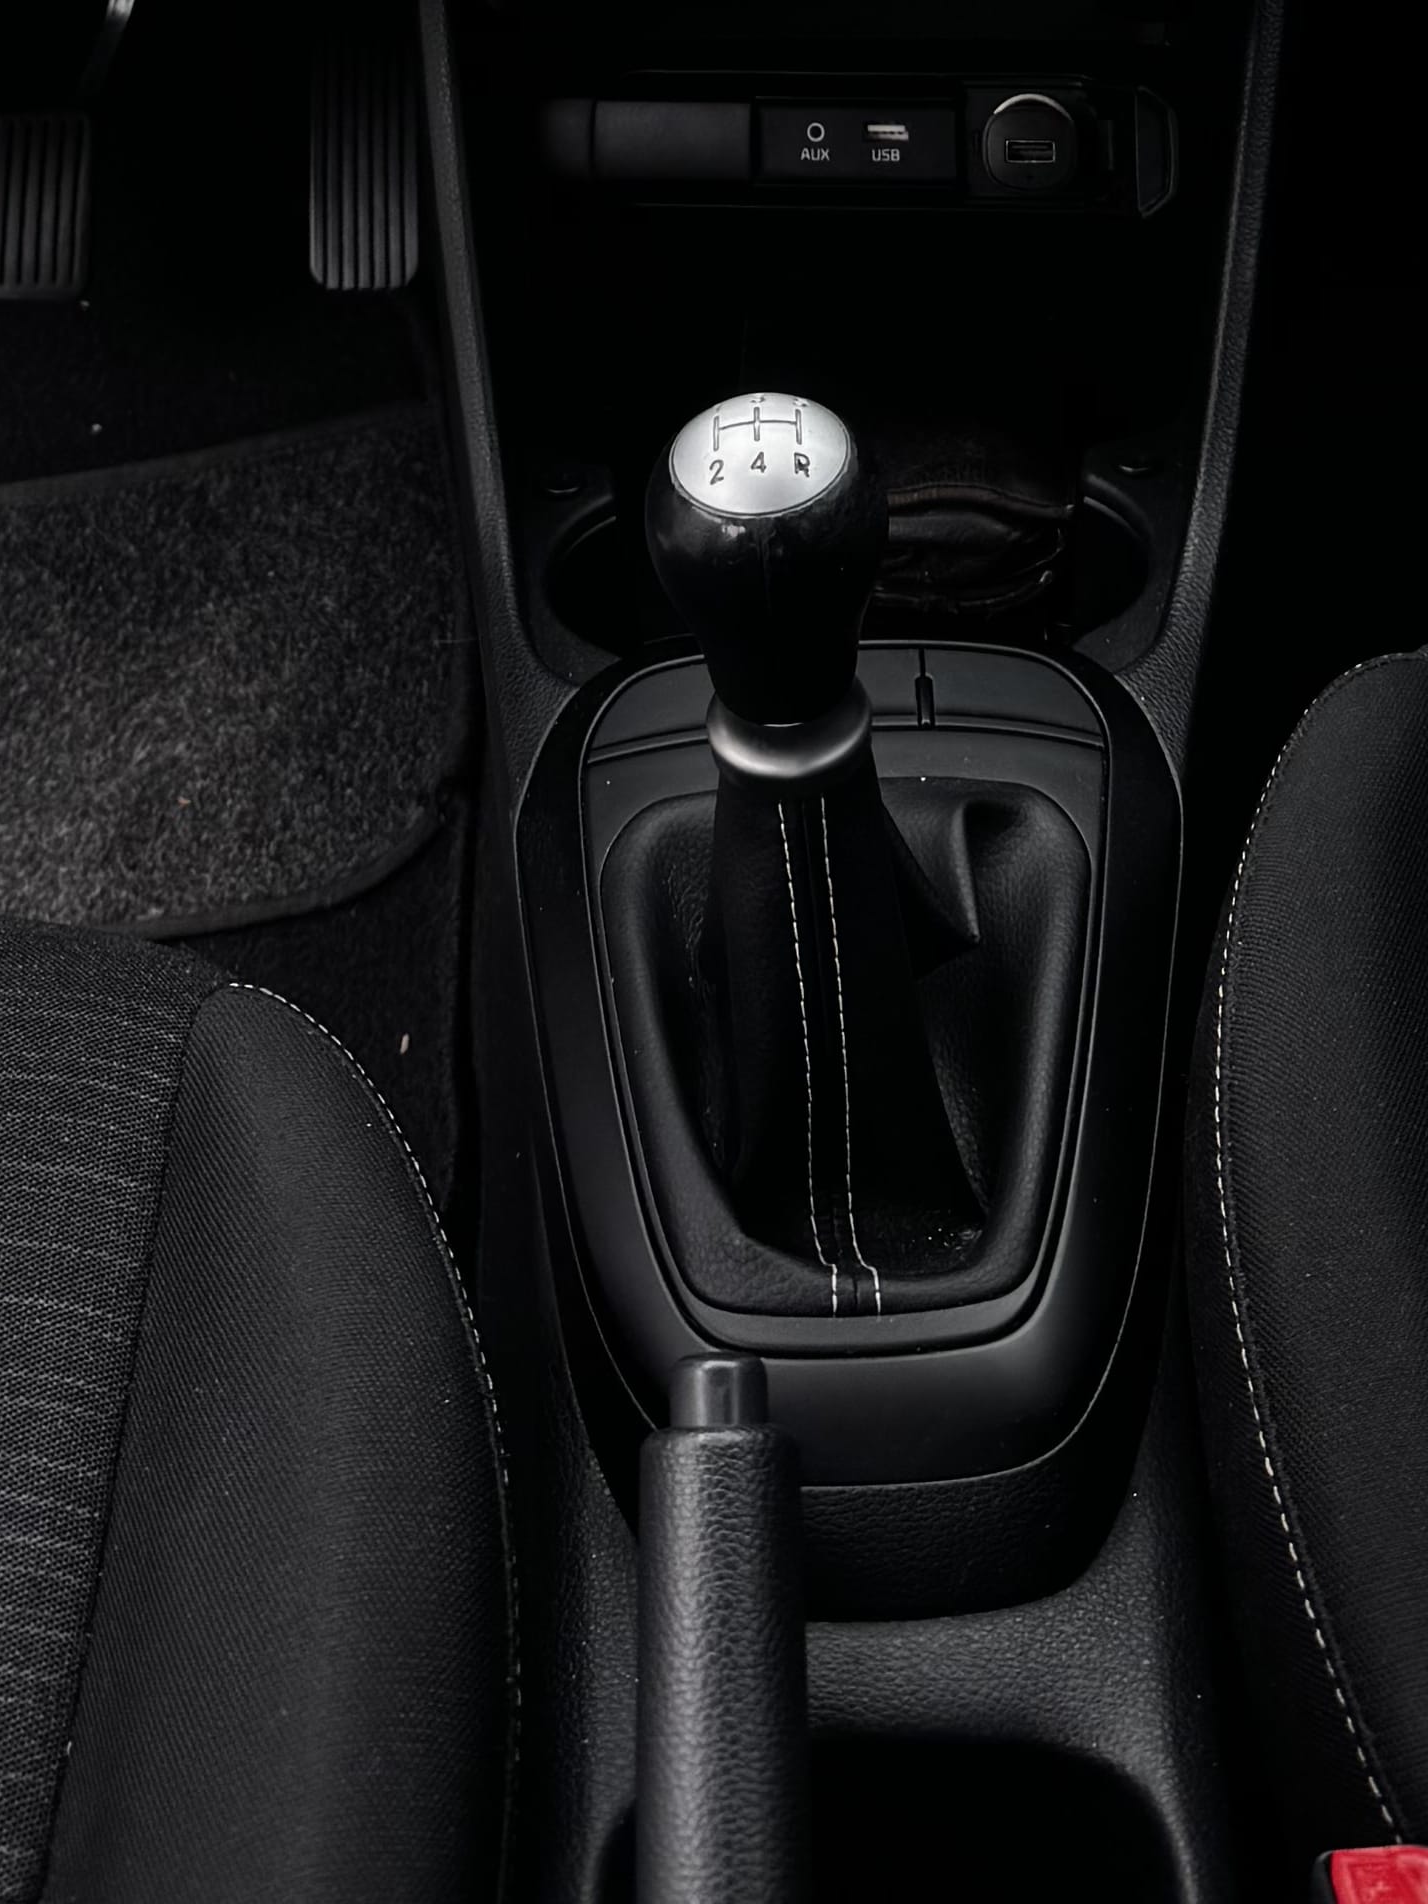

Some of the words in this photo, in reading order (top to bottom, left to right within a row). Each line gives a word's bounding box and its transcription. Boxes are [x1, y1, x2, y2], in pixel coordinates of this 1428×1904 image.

[801, 147, 831, 162] AUX
[871, 148, 901, 163] USB
[709, 459, 725, 485] 2
[751, 451, 767, 474] 4
[793, 452, 811, 478] R
